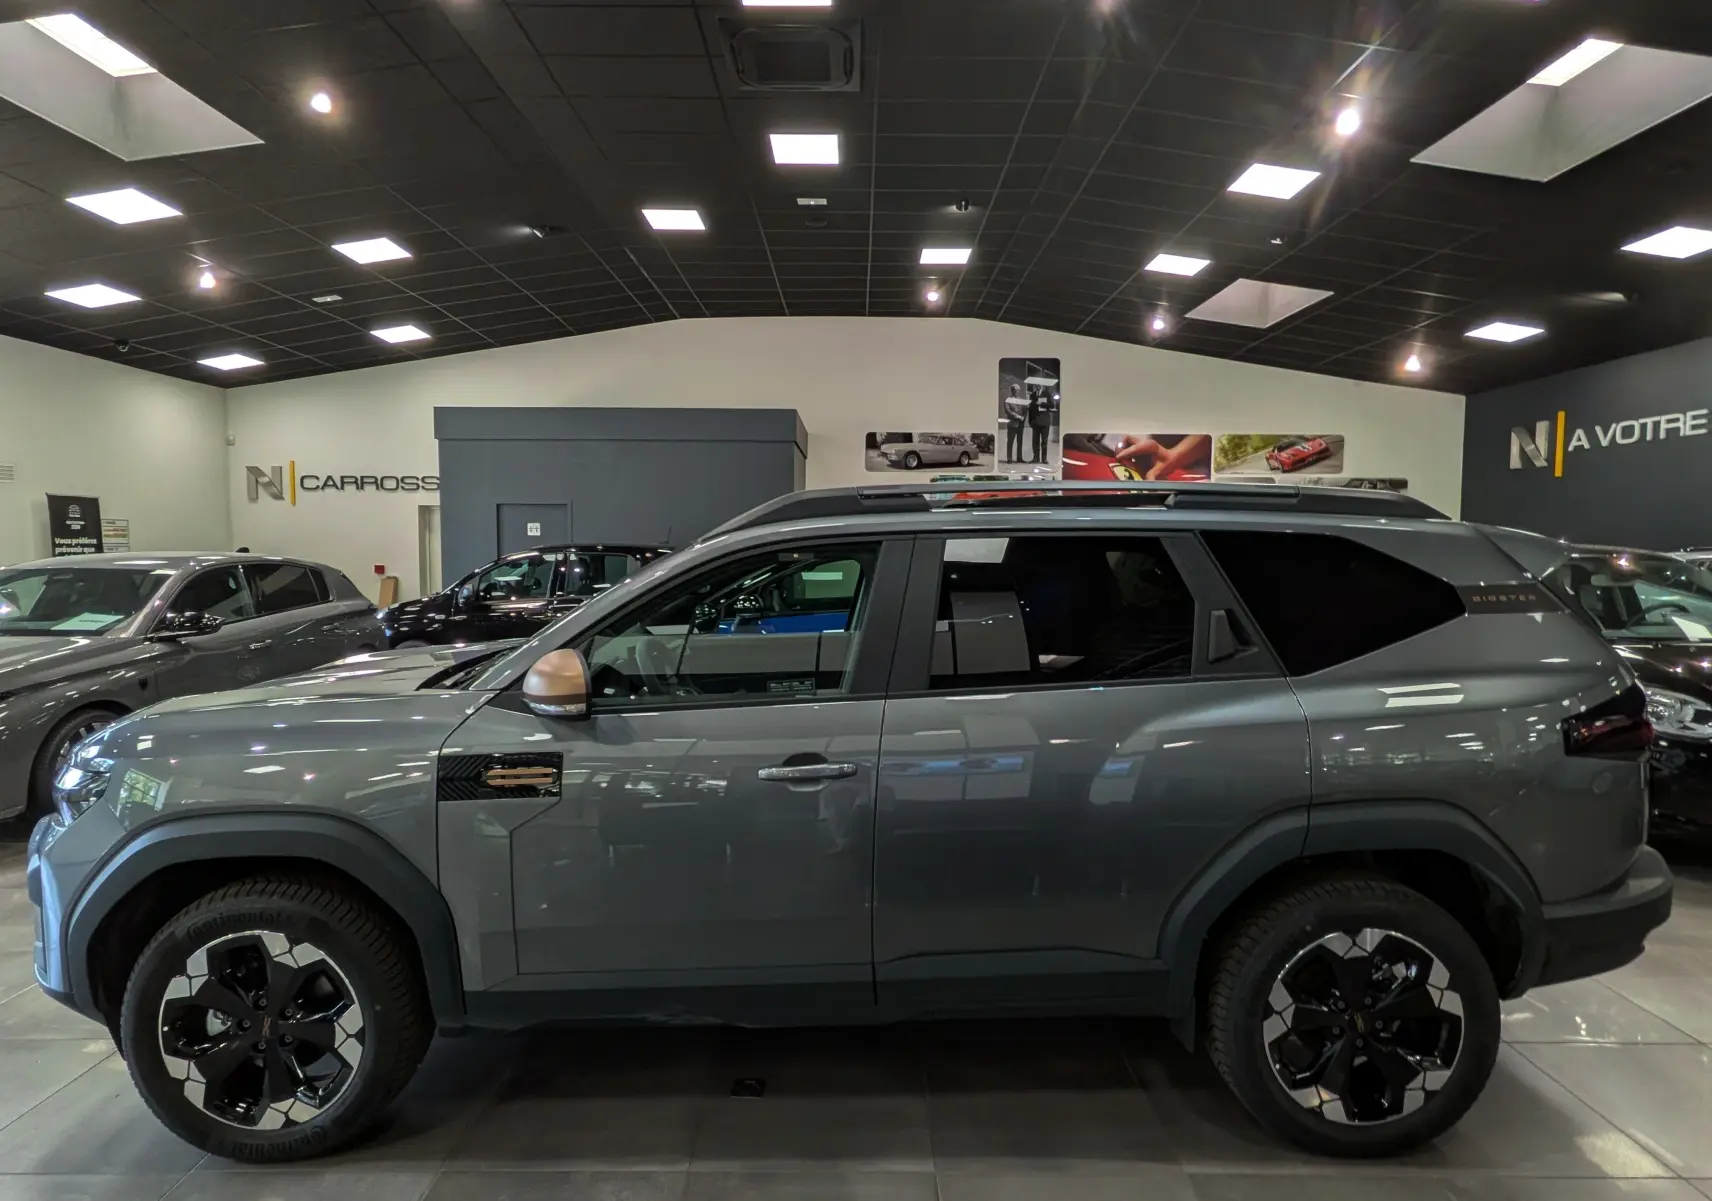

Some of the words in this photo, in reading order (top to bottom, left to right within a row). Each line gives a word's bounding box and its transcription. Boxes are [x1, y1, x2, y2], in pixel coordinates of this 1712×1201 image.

[1567, 428, 1591, 452] A
[1594, 408, 1710, 447] VOTRE
[300, 474, 440, 491] CARROSS
[54, 537, 72, 545] Vous
[55, 545, 83, 554] prévenir
